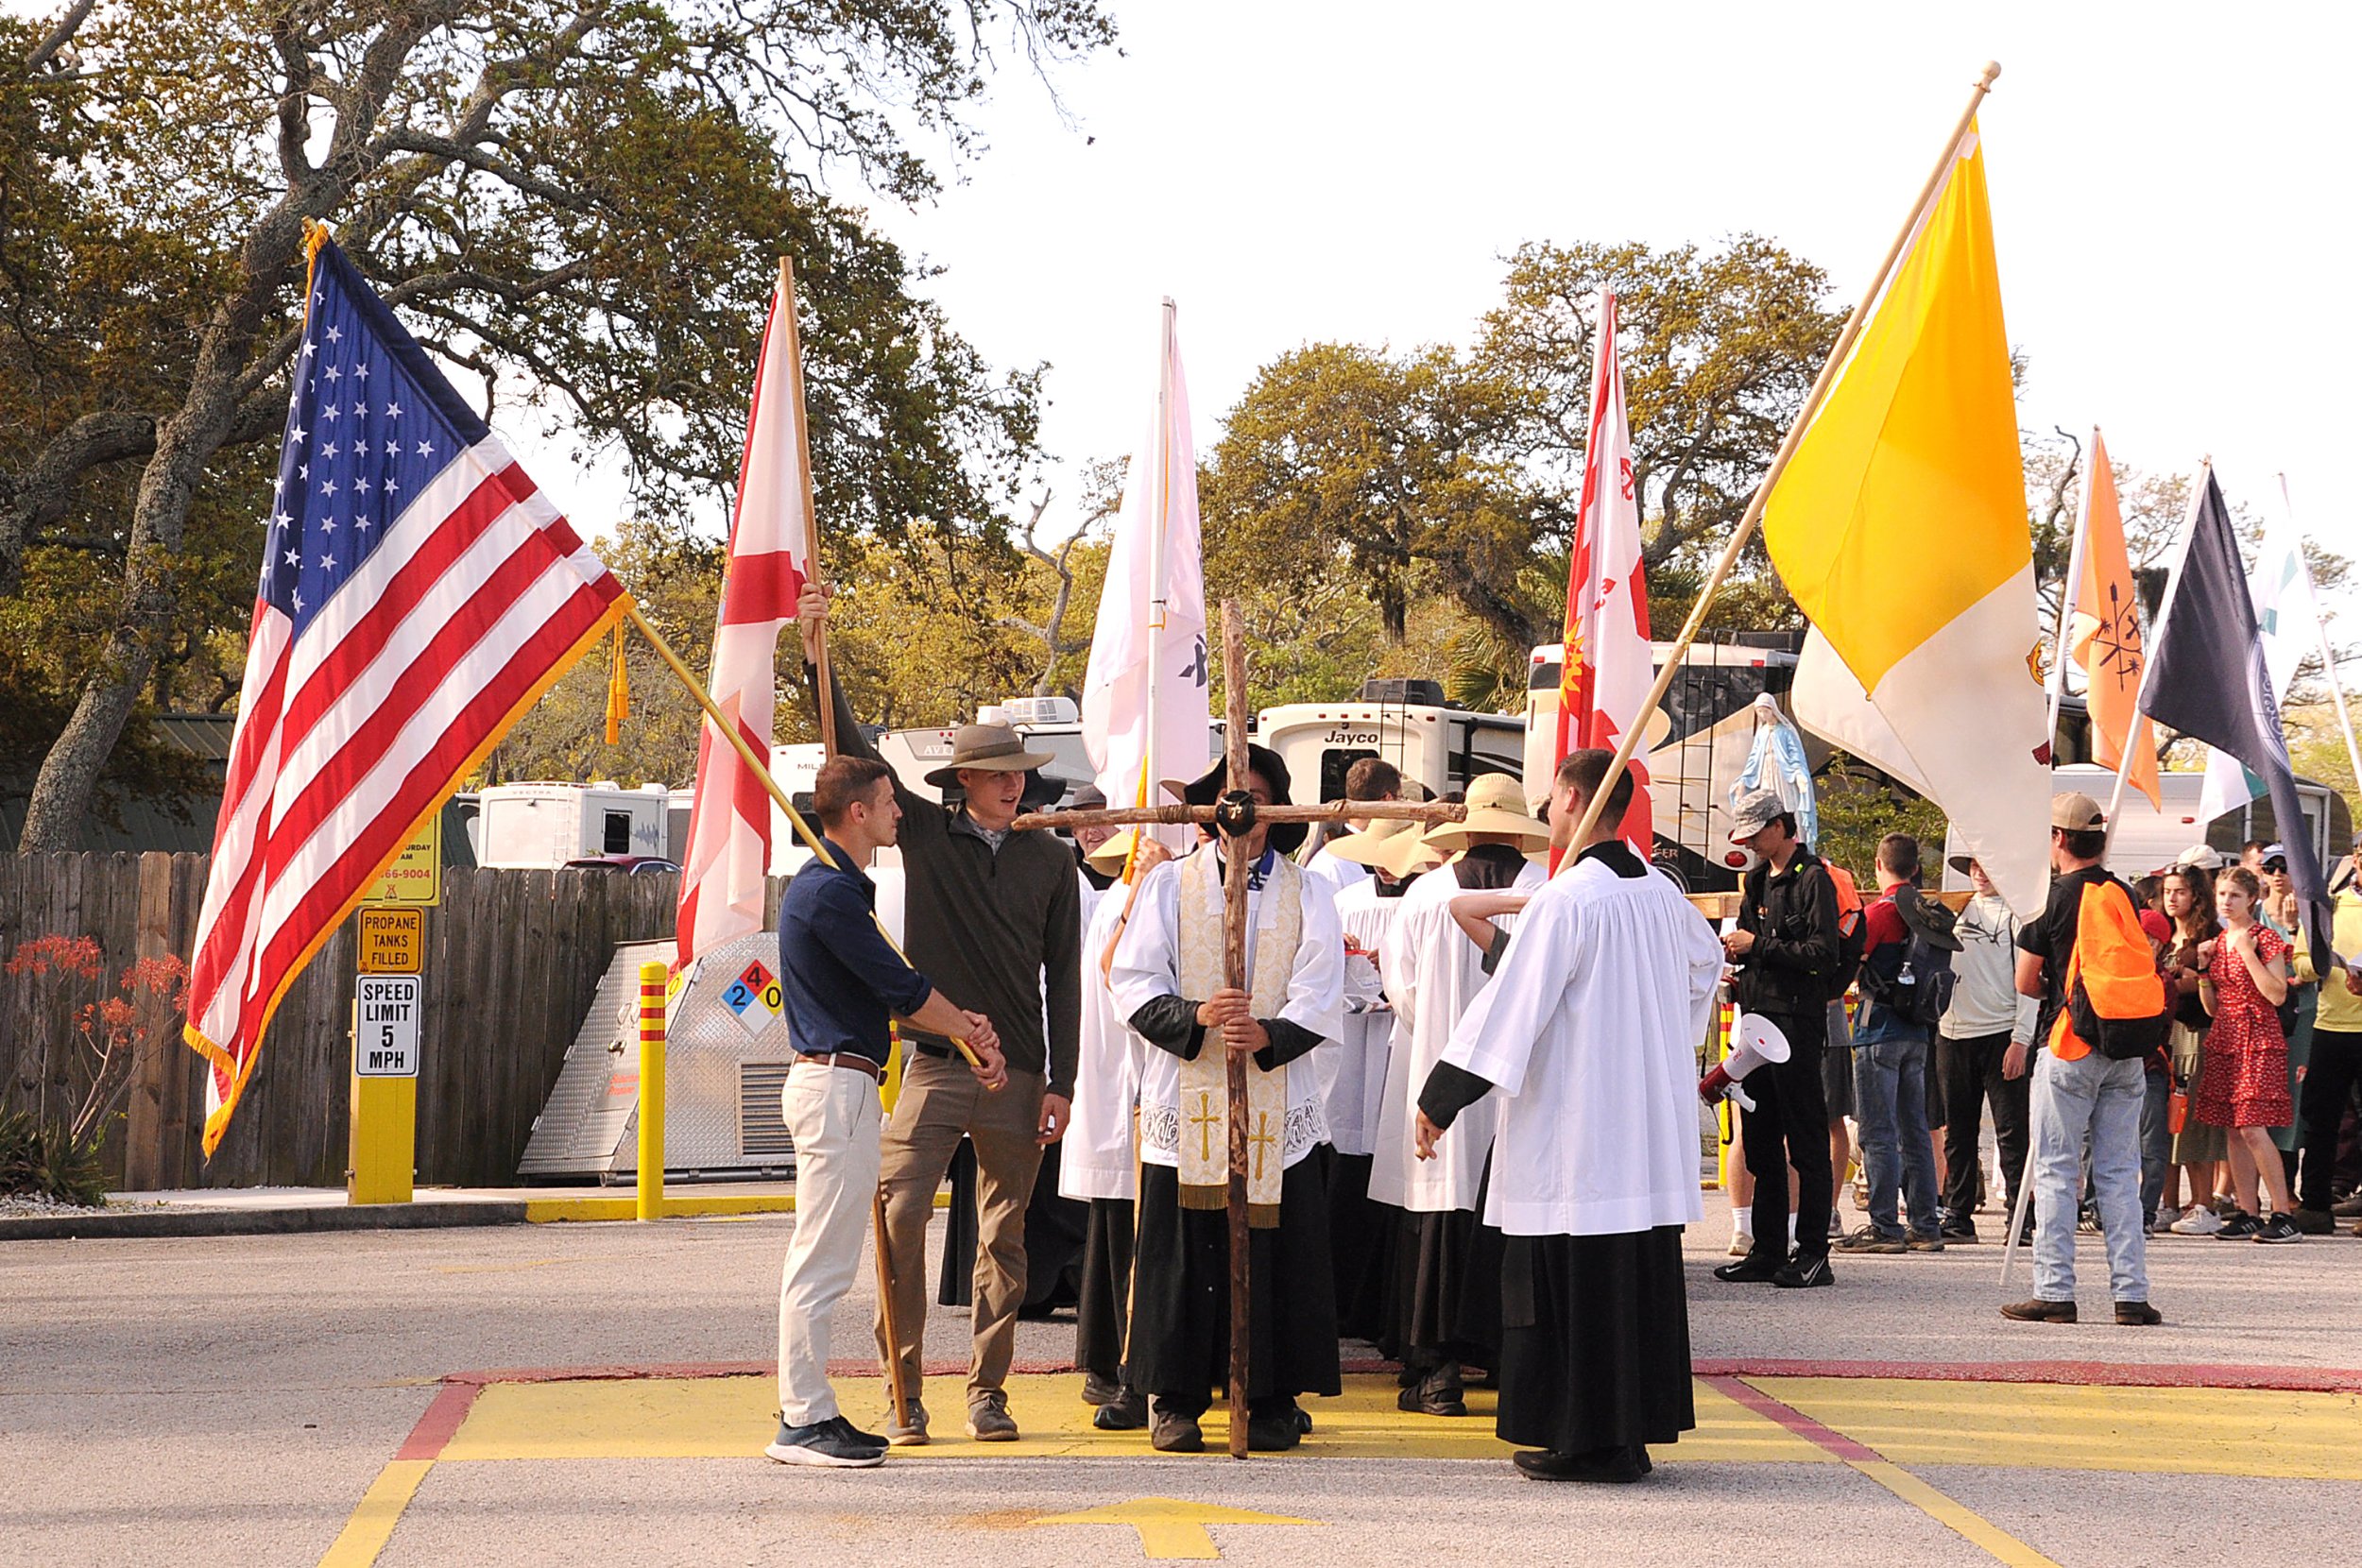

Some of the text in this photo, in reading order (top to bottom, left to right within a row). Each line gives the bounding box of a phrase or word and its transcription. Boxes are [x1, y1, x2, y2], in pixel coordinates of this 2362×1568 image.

[1325, 730, 1378, 746] Jayco
[381, 869, 431, 878] 66-9004
[365, 916, 418, 930] PROPANE
[373, 934, 409, 948] TANKS
[371, 951, 409, 965] FILLED
[746, 966, 762, 987] 4
[364, 983, 414, 1001] SPEED
[731, 984, 782, 1008] 2 0
[366, 1004, 411, 1022] LIMIT
[381, 1025, 394, 1048] 5
[369, 1050, 404, 1069] MPH
